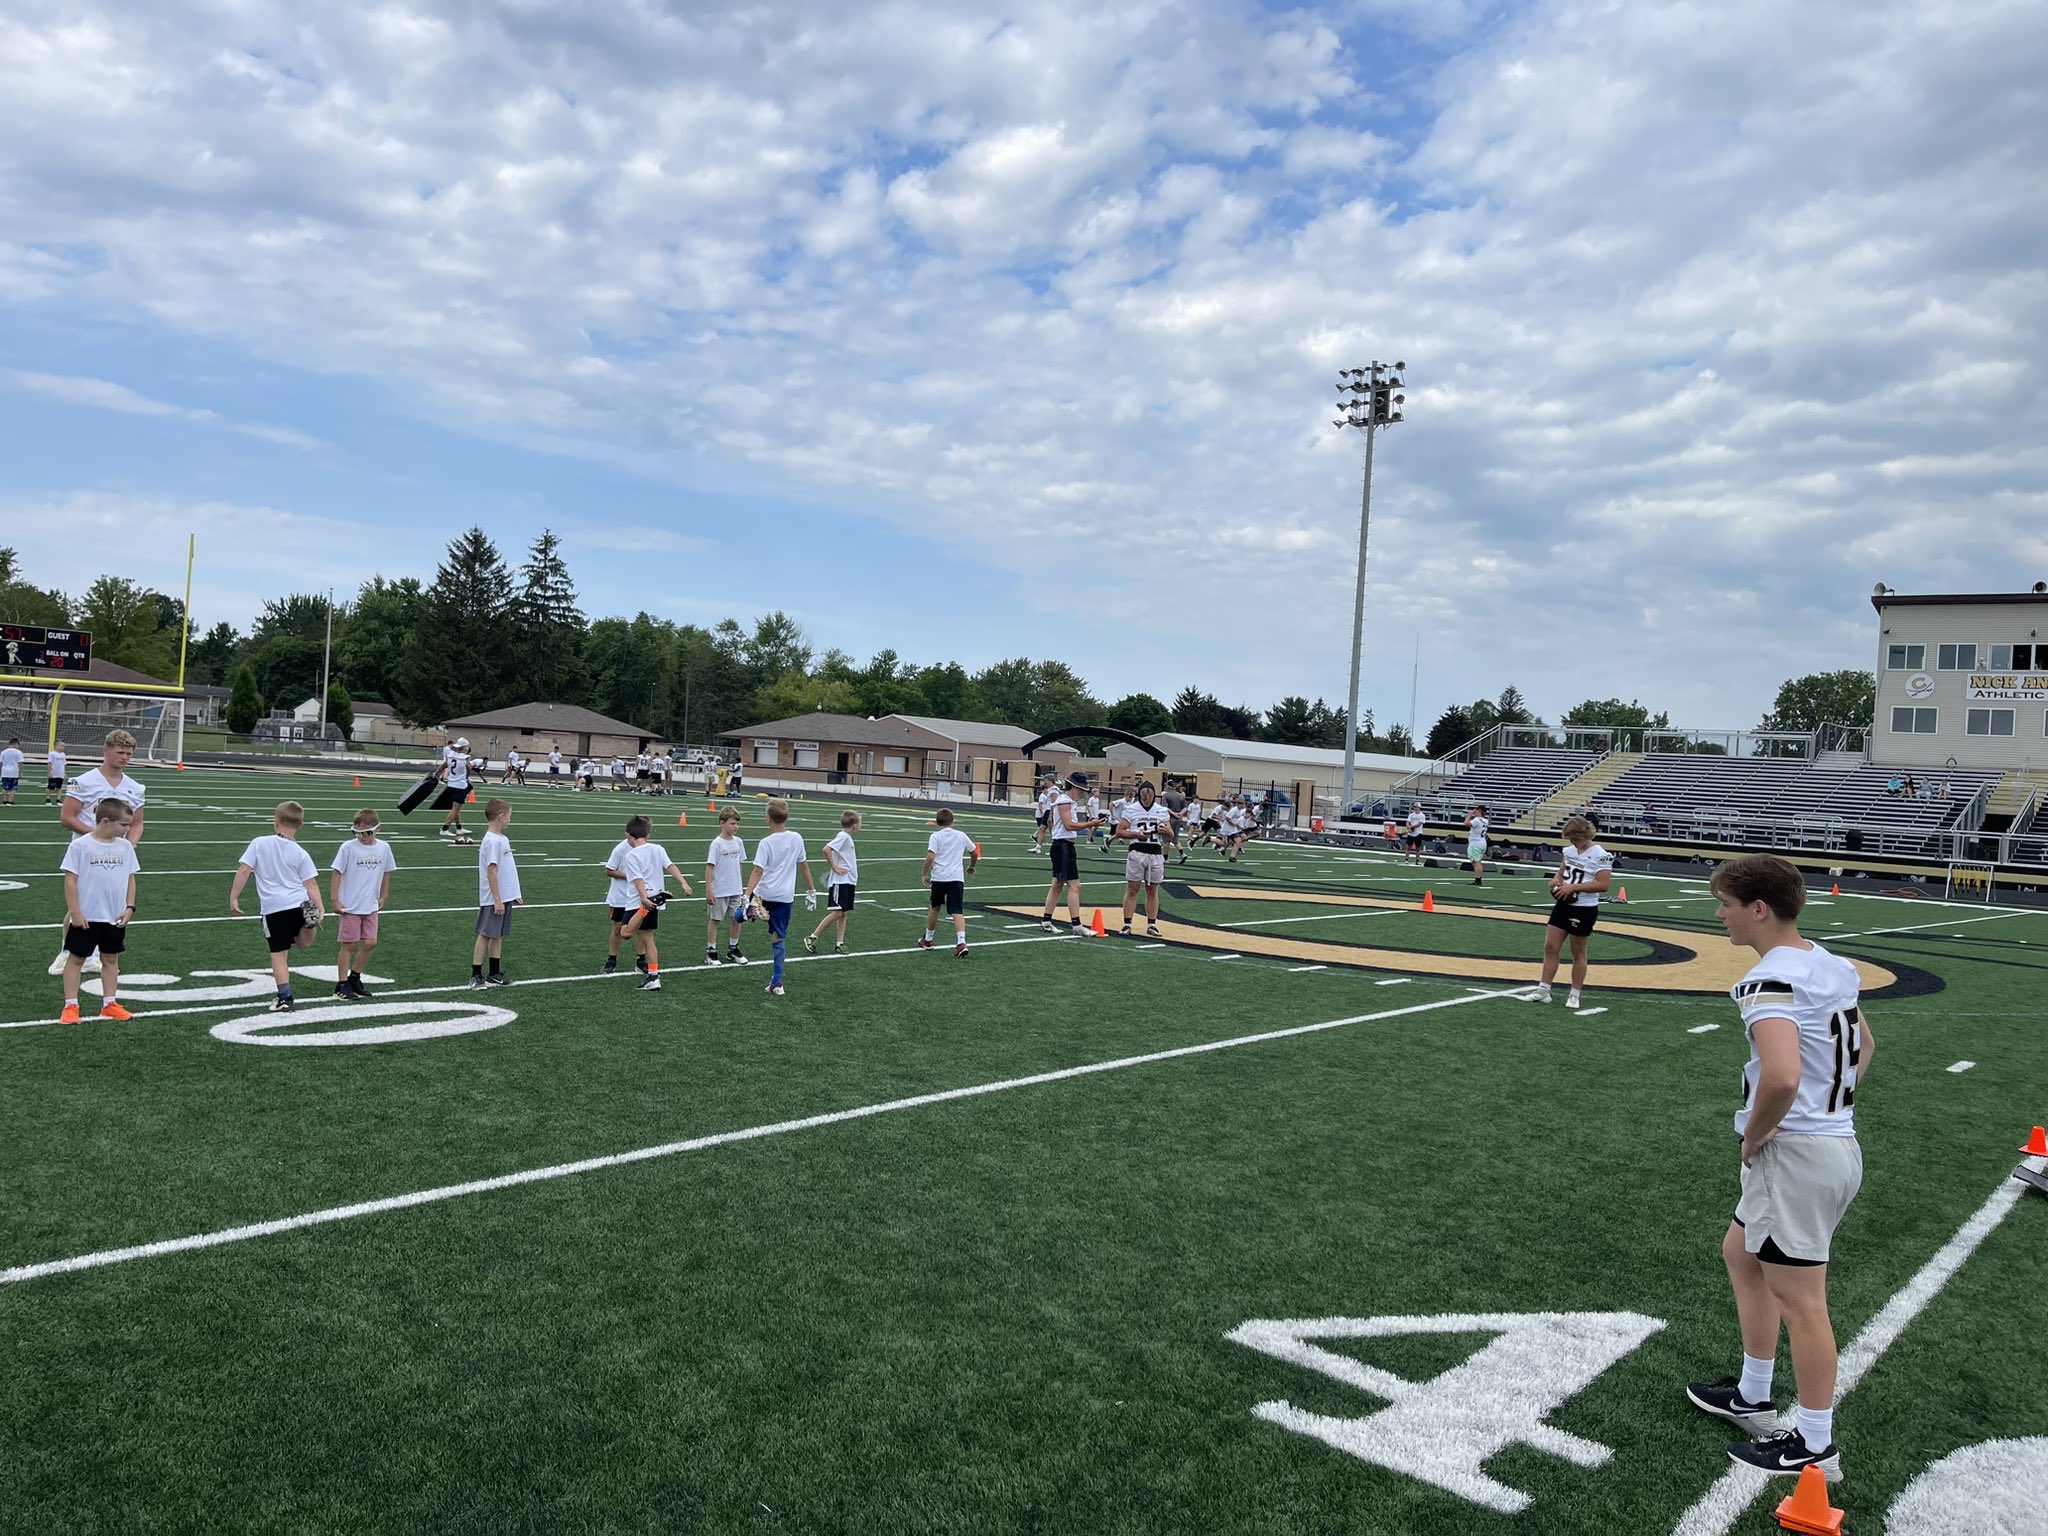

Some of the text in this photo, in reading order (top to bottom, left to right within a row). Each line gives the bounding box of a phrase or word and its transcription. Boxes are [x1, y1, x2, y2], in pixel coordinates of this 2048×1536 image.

[47, 632, 70, 640] GUEST
[1970, 675, 2018, 689] NICK
[1825, 1006, 1861, 1116] 15
[1224, 1310, 1669, 1515] 4
